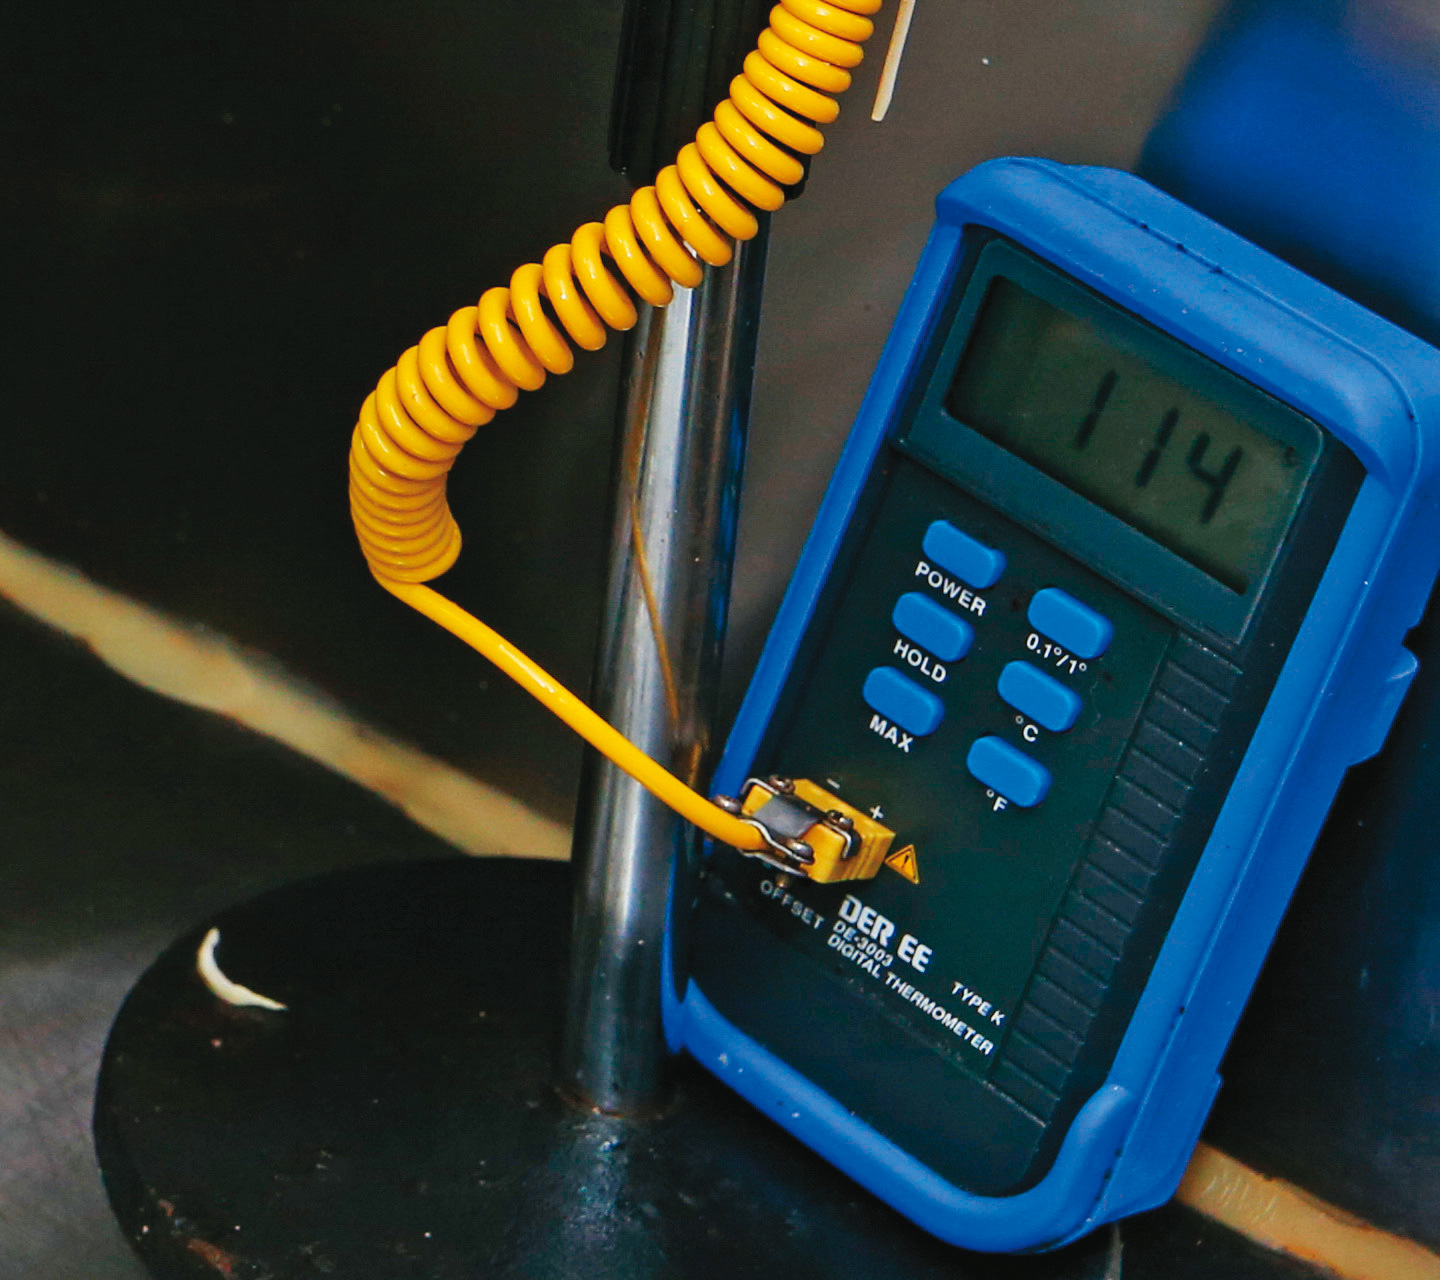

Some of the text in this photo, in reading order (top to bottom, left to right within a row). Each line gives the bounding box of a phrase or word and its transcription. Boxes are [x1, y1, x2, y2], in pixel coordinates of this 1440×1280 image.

[1074, 368, 1244, 525] 114
[914, 561, 987, 616] POWER
[893, 638, 947, 683] HOLD
[869, 714, 914, 753] MAX
[1015, 715, 1039, 742] °C
[986, 788, 1008, 812] °F
[760, 879, 825, 930] OFFSET
[832, 920, 894, 967] DE-3003
[838, 894, 933, 973] DER EE
[827, 933, 994, 1056] DIGITAL THERMOMETER
[951, 981, 1005, 1026] TYPE K
